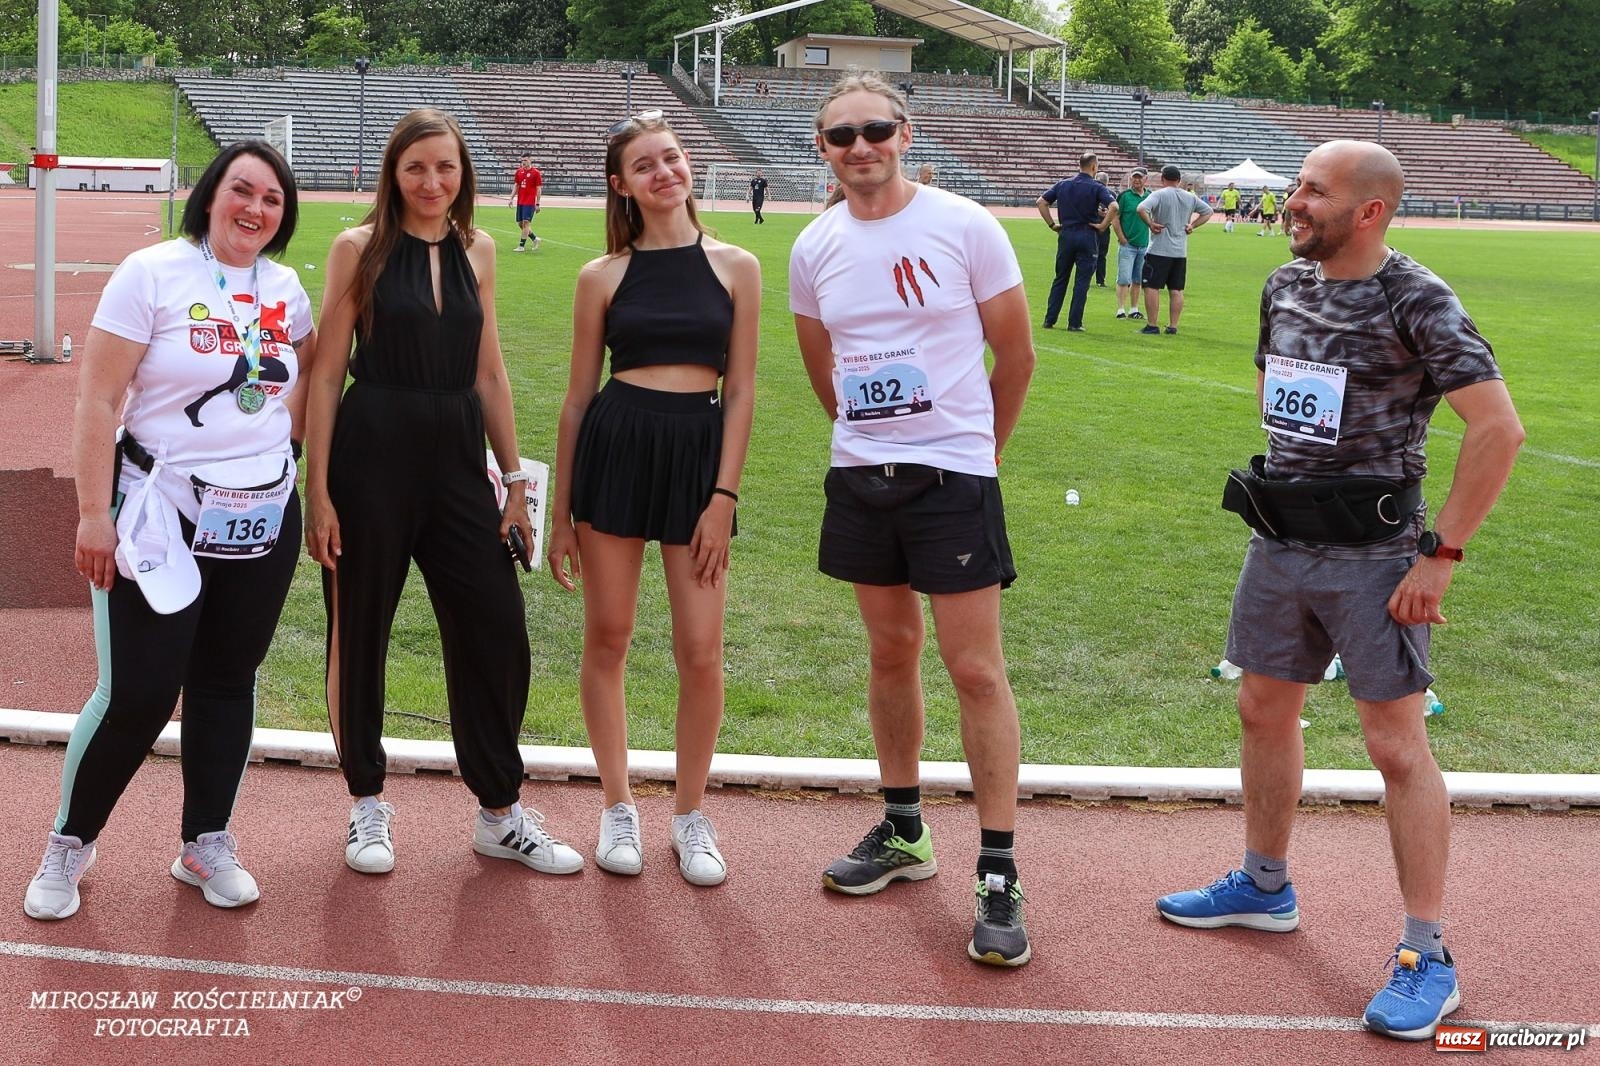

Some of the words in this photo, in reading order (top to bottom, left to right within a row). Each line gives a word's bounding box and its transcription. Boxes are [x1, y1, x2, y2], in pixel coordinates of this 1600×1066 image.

[854, 355, 868, 363] BIEG
[869, 353, 883, 361] BEZ
[884, 347, 916, 359] GRANIC
[1280, 358, 1295, 368] BIEG
[1295, 361, 1308, 371] BEZ
[1309, 364, 1340, 376] GRANIC
[859, 378, 904, 405] 182
[1274, 387, 1318, 419] 266
[213, 488, 230, 499] XVII
[231, 491, 250, 500] BIEG
[250, 491, 264, 500] BEZ
[232, 501, 248, 509] 2025
[226, 517, 267, 541] 136
